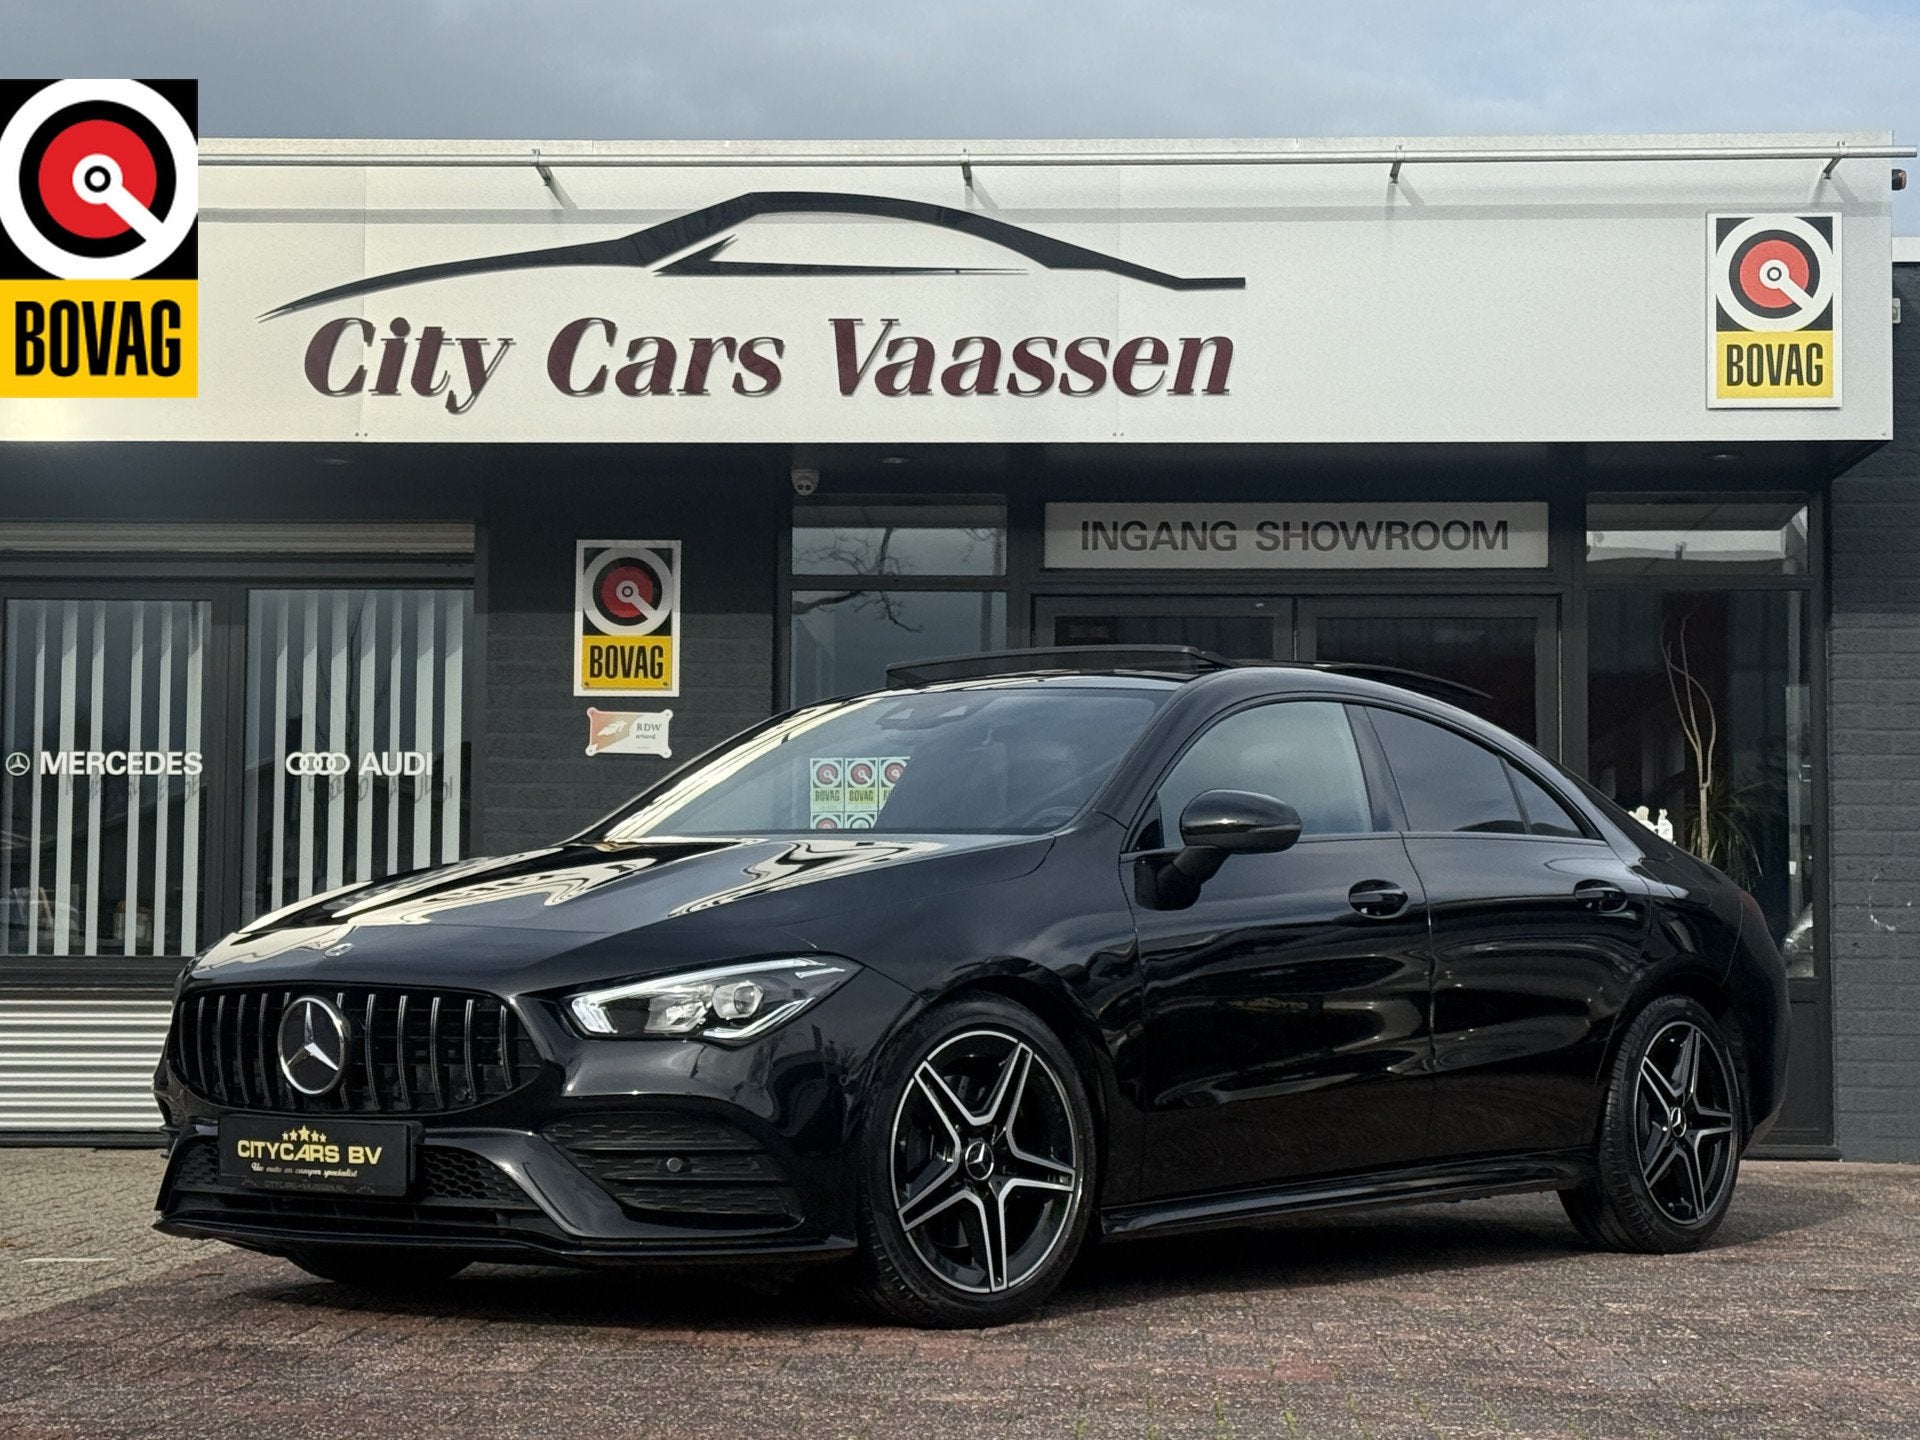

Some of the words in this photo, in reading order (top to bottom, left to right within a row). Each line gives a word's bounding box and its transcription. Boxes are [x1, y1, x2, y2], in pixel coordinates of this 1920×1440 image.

[304, 316, 516, 414] City
[547, 316, 784, 398] Cars
[828, 317, 1234, 398] Vaassen
[1726, 342, 1824, 387] BOVAG
[1081, 520, 1237, 552] INGANG
[1255, 519, 1509, 552] SHOWROOM
[589, 644, 664, 680] BOVAG
[636, 722, 661, 731] RDW
[40, 751, 203, 776] MERCEDES
[358, 752, 433, 776] AUDI
[815, 789, 840, 802] BOVAG
[237, 1139, 340, 1164] CITYCARS
[348, 1145, 383, 1165] BV
[295, 1167, 322, 1177] camper
[323, 1168, 358, 1178] specialist
